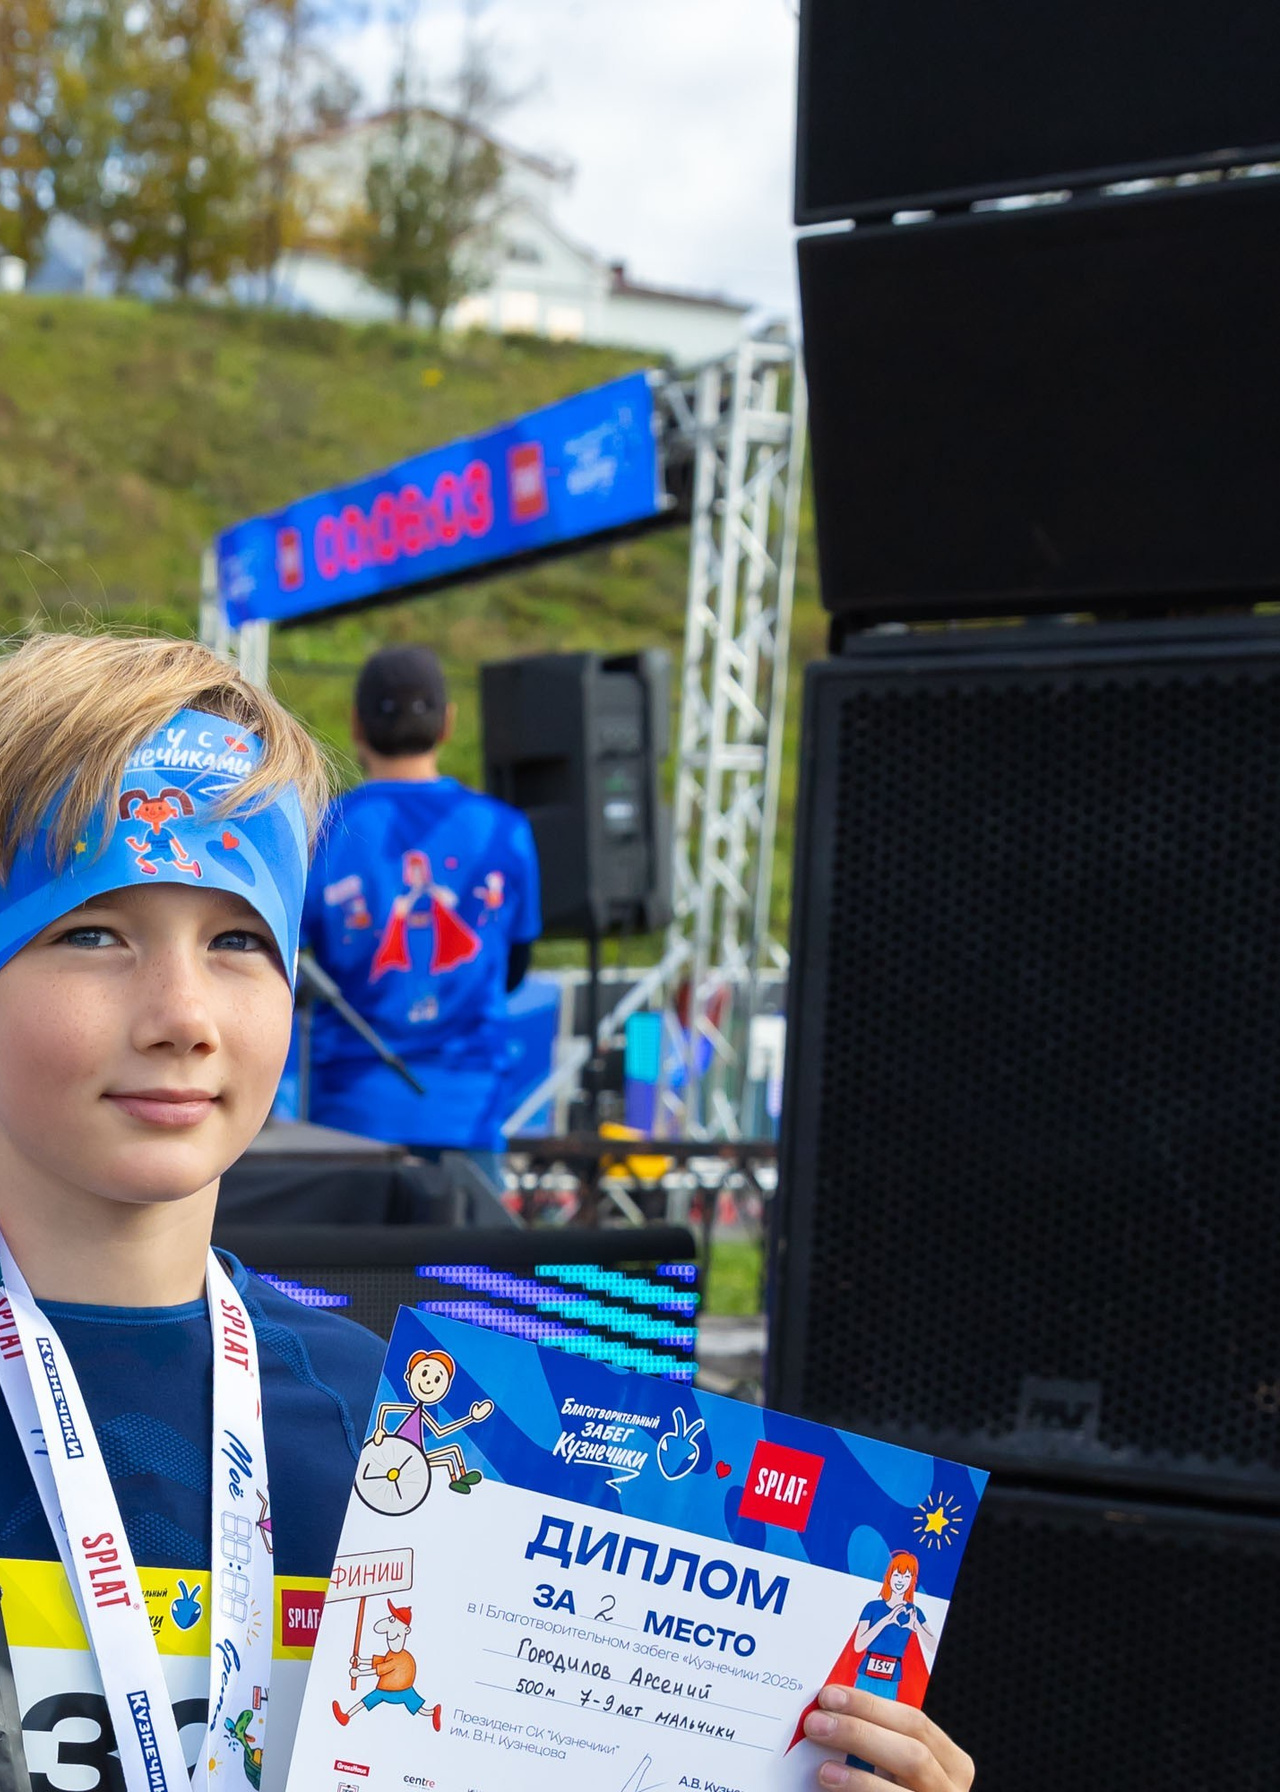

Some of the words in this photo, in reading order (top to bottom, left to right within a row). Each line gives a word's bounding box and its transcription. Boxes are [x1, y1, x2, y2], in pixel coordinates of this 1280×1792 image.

[221, 1299, 249, 1371] SPLAT
[37, 1338, 84, 1459] КУЗНЕЧИКИ
[581, 1422, 634, 1443] ЗАБЕГ
[754, 1467, 807, 1505] SPLAT
[82, 1533, 129, 1608] SPLAT
[330, 1561, 404, 1589] ФИНИШ
[524, 1514, 790, 1615] ДИПЛОМ
[288, 1607, 319, 1630] SPLAT
[533, 1584, 576, 1614] ЗА
[594, 1595, 616, 1621] 2
[643, 1610, 756, 1657] МЕСТО
[467, 1602, 476, 1613] в
[486, 1605, 630, 1651] Благотворительном
[632, 1642, 679, 1664] забеге
[682, 1653, 760, 1682] «Кузнечики
[762, 1672, 803, 1692] 2025»
[453, 1708, 523, 1734] Президент
[526, 1727, 545, 1740] СК
[450, 1728, 469, 1741] им.
[473, 1731, 495, 1745] В.Н.
[498, 1736, 566, 1760] Кузнецова
[403, 1775, 435, 1788] centre
[679, 1776, 702, 1790] А.В.
